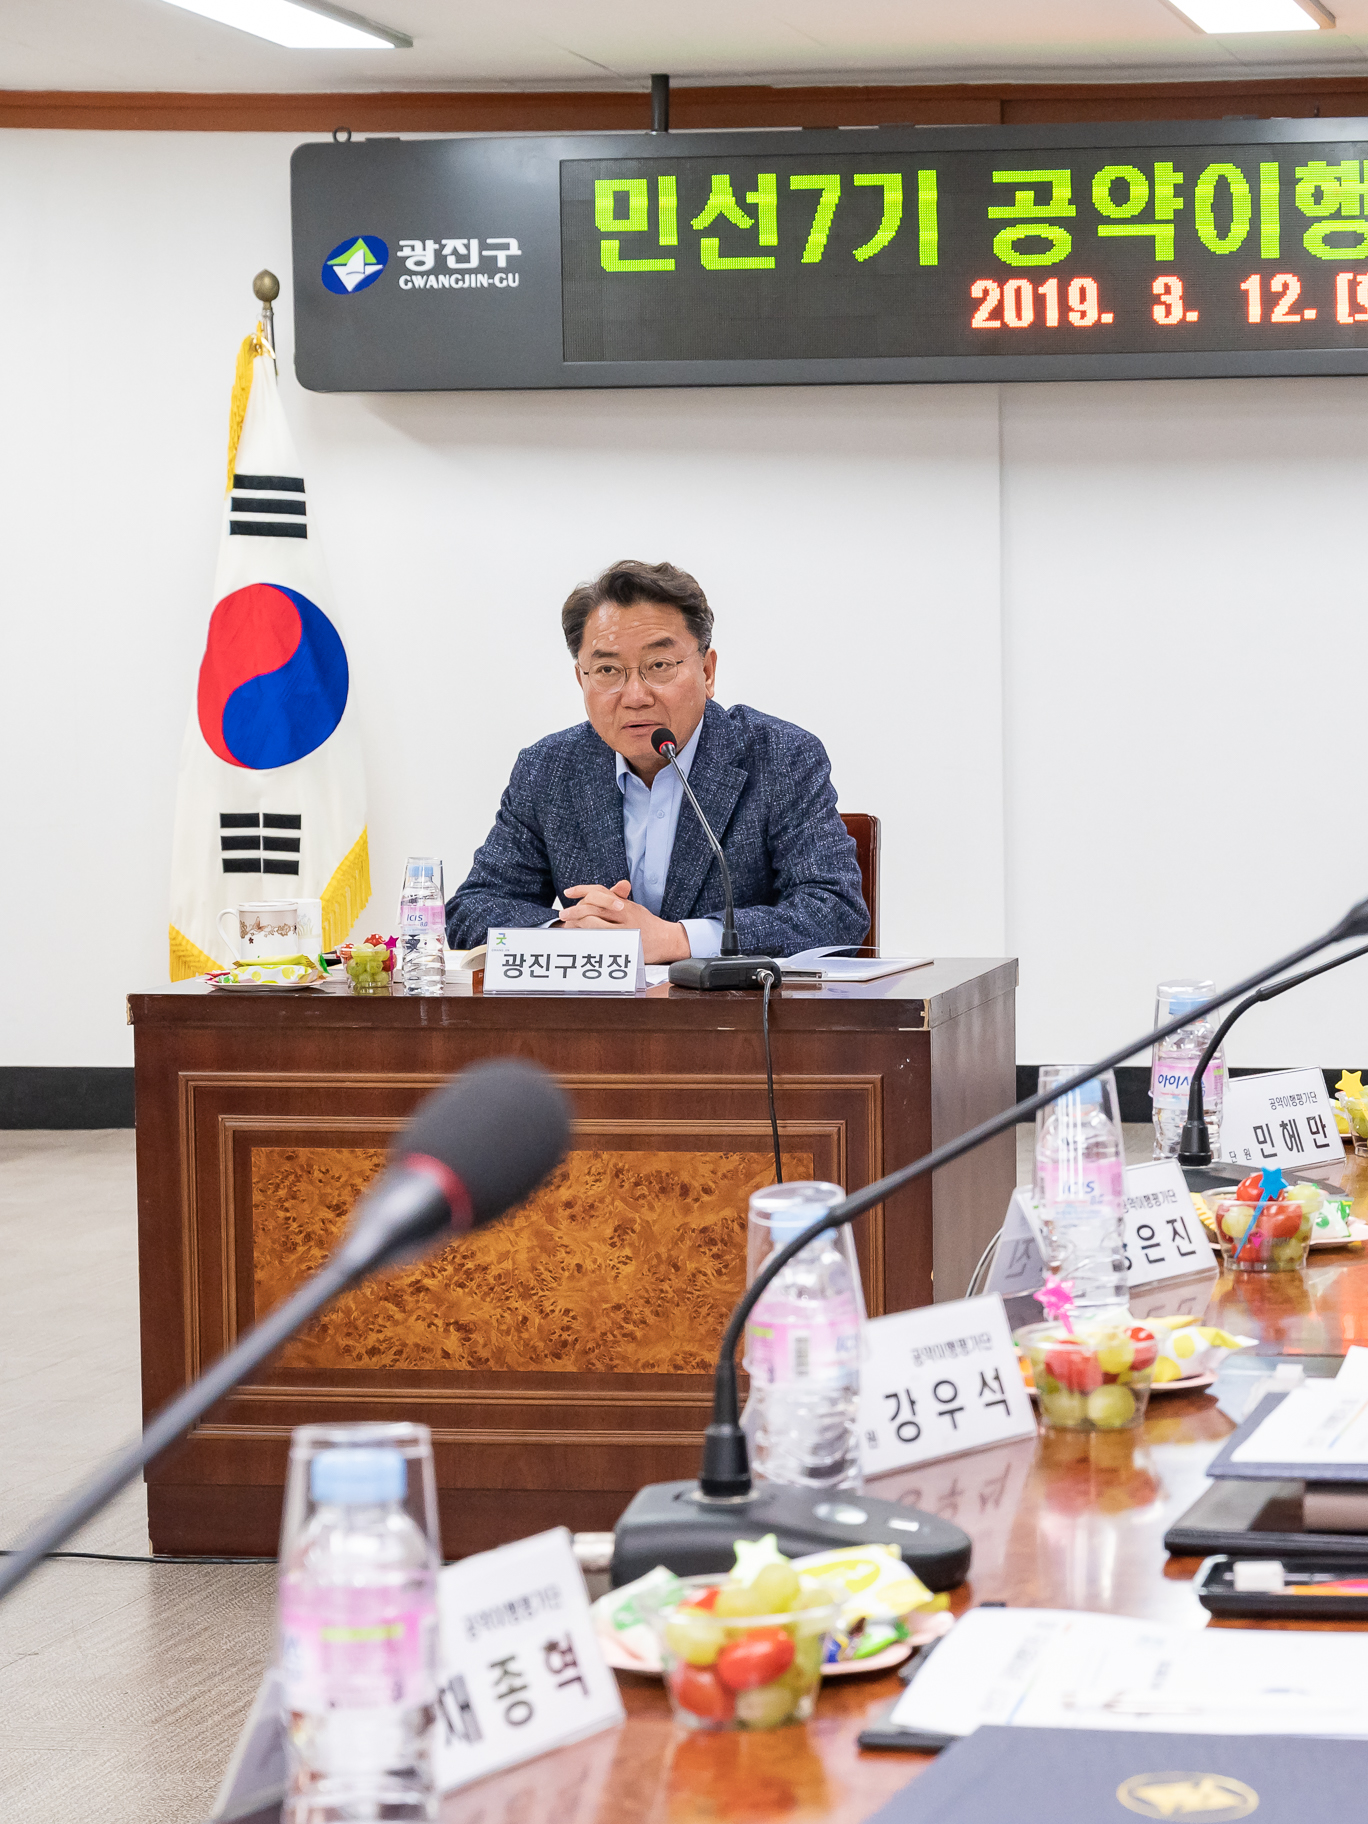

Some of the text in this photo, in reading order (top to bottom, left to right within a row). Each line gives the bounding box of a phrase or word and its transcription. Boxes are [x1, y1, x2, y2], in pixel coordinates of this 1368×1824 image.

[594, 169, 940, 272] 민선7기
[397, 237, 522, 271] 광진구
[399, 273, 520, 290] GWANGJIN-GU
[970, 277, 1114, 329] 2019.
[1152, 275, 1199, 326] 3.
[501, 953, 632, 980] 광진구청장
[884, 1367, 1011, 1443] 강우석
